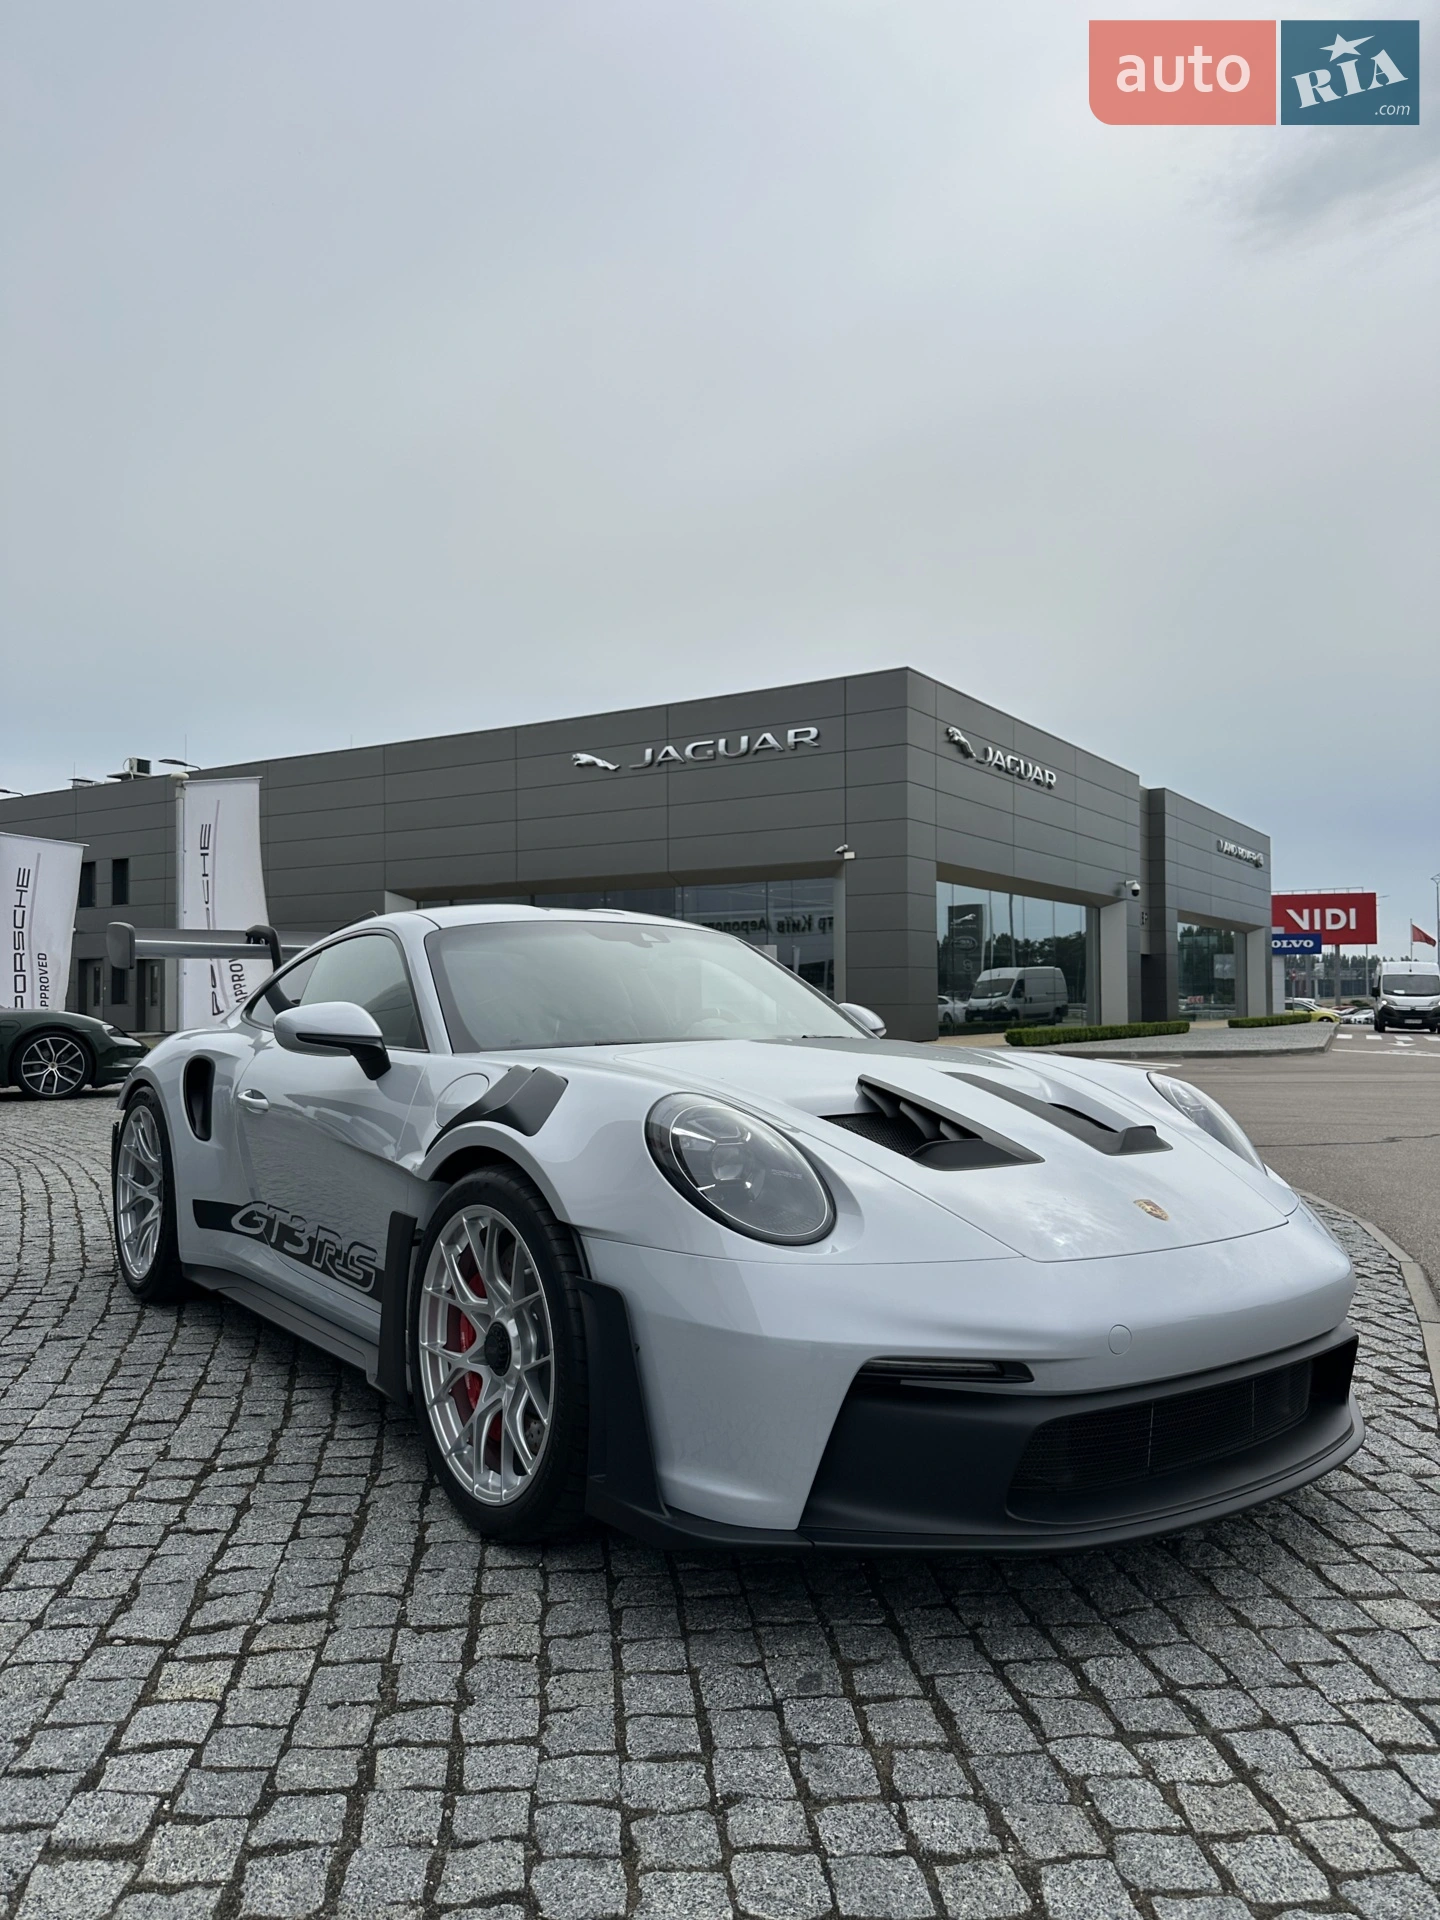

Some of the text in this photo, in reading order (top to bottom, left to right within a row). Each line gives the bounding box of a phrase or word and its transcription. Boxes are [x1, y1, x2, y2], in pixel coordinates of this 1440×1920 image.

[629, 726, 821, 770] JAGUAR
[976, 746, 1057, 788] JAGUAR
[1286, 907, 1357, 931] VIDI
[1271, 939, 1314, 948] OLVO
[37, 952, 50, 1009] PPROVED
[229, 959, 249, 1003] APPRO
